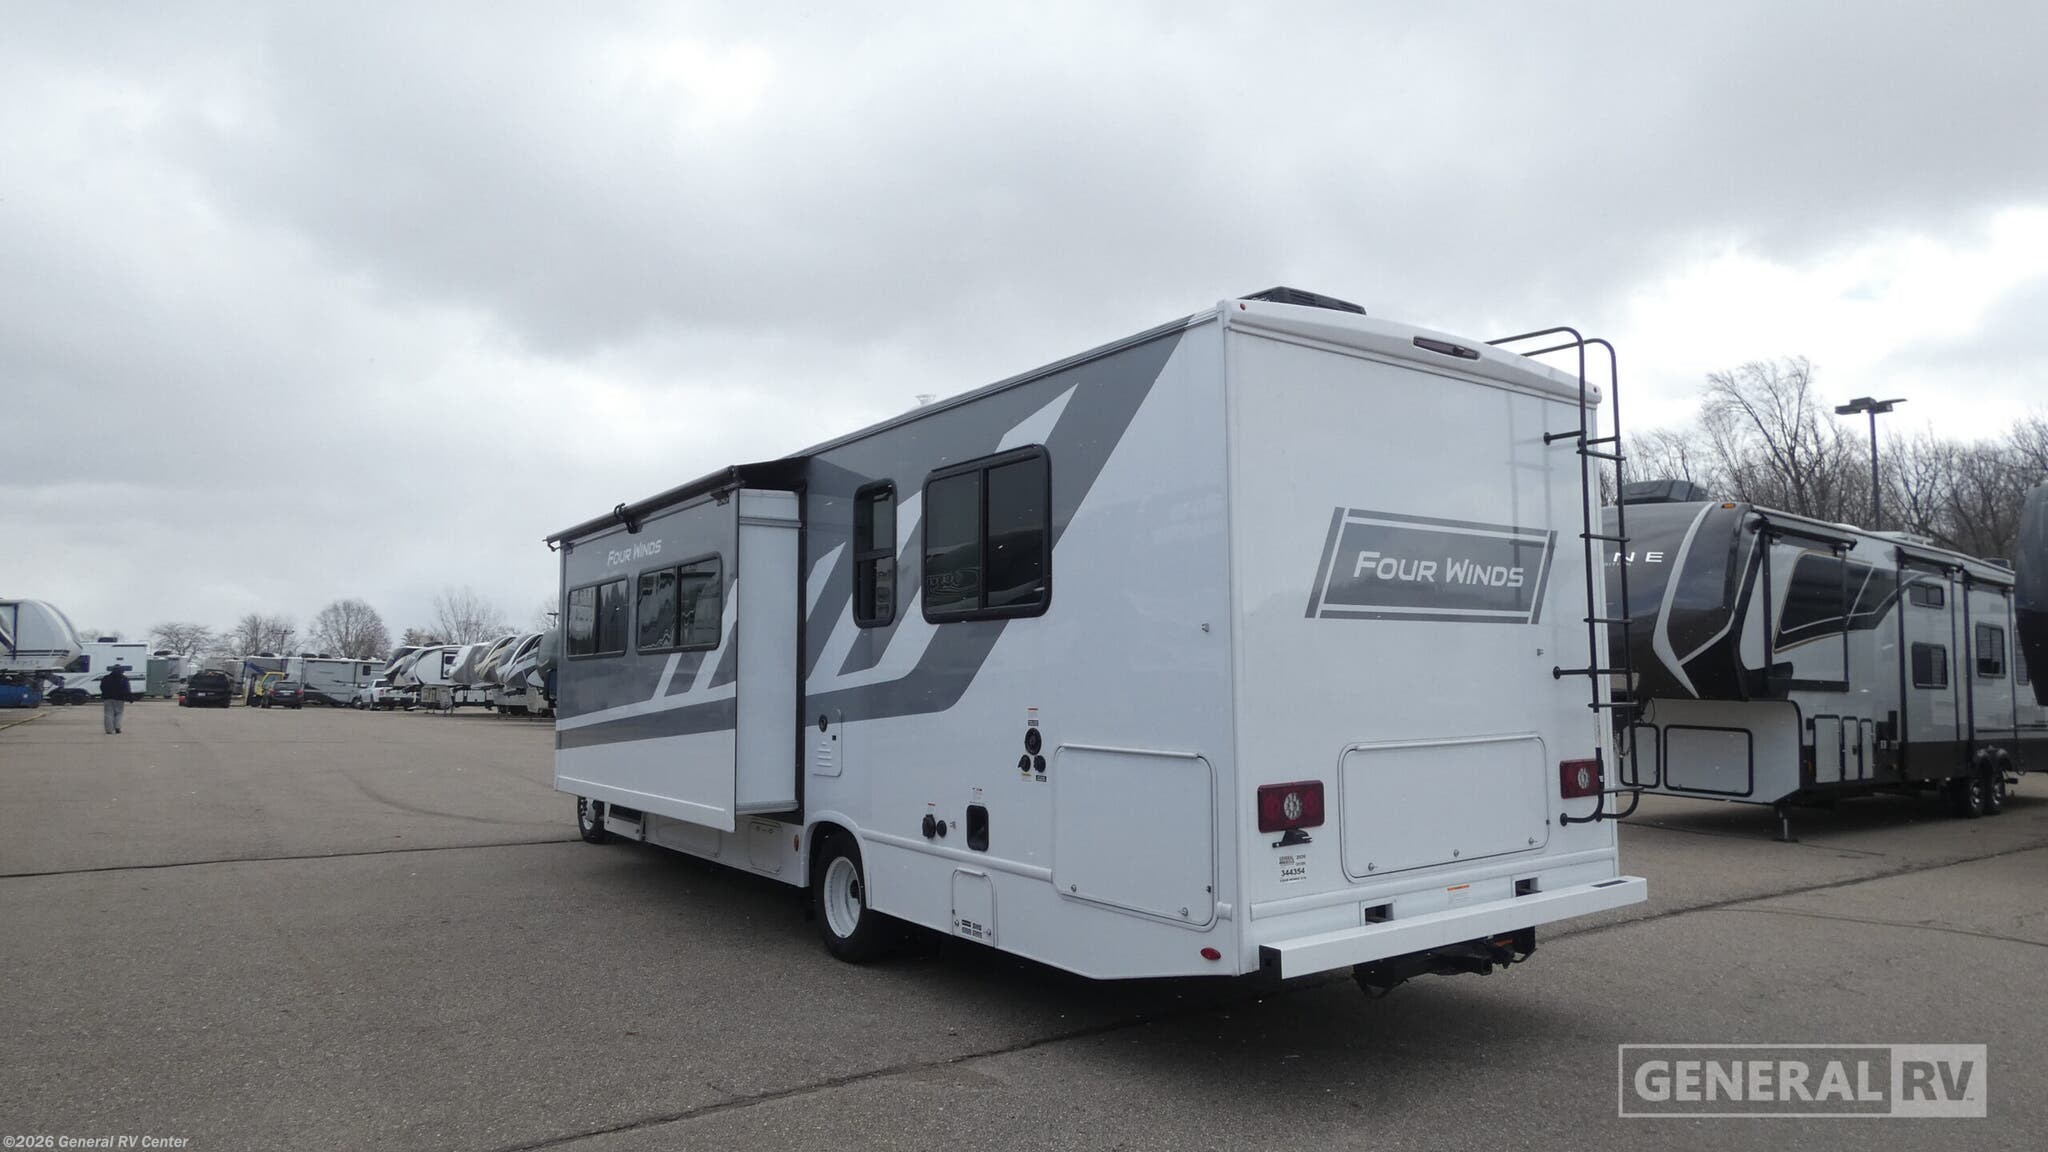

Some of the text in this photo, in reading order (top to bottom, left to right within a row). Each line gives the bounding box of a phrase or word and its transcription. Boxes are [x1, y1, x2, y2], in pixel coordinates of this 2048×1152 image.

[607, 540, 662, 566] FOUR WINDS
[1353, 550, 1524, 587] FOUR WINDS
[1281, 867, 1305, 877] 344354
